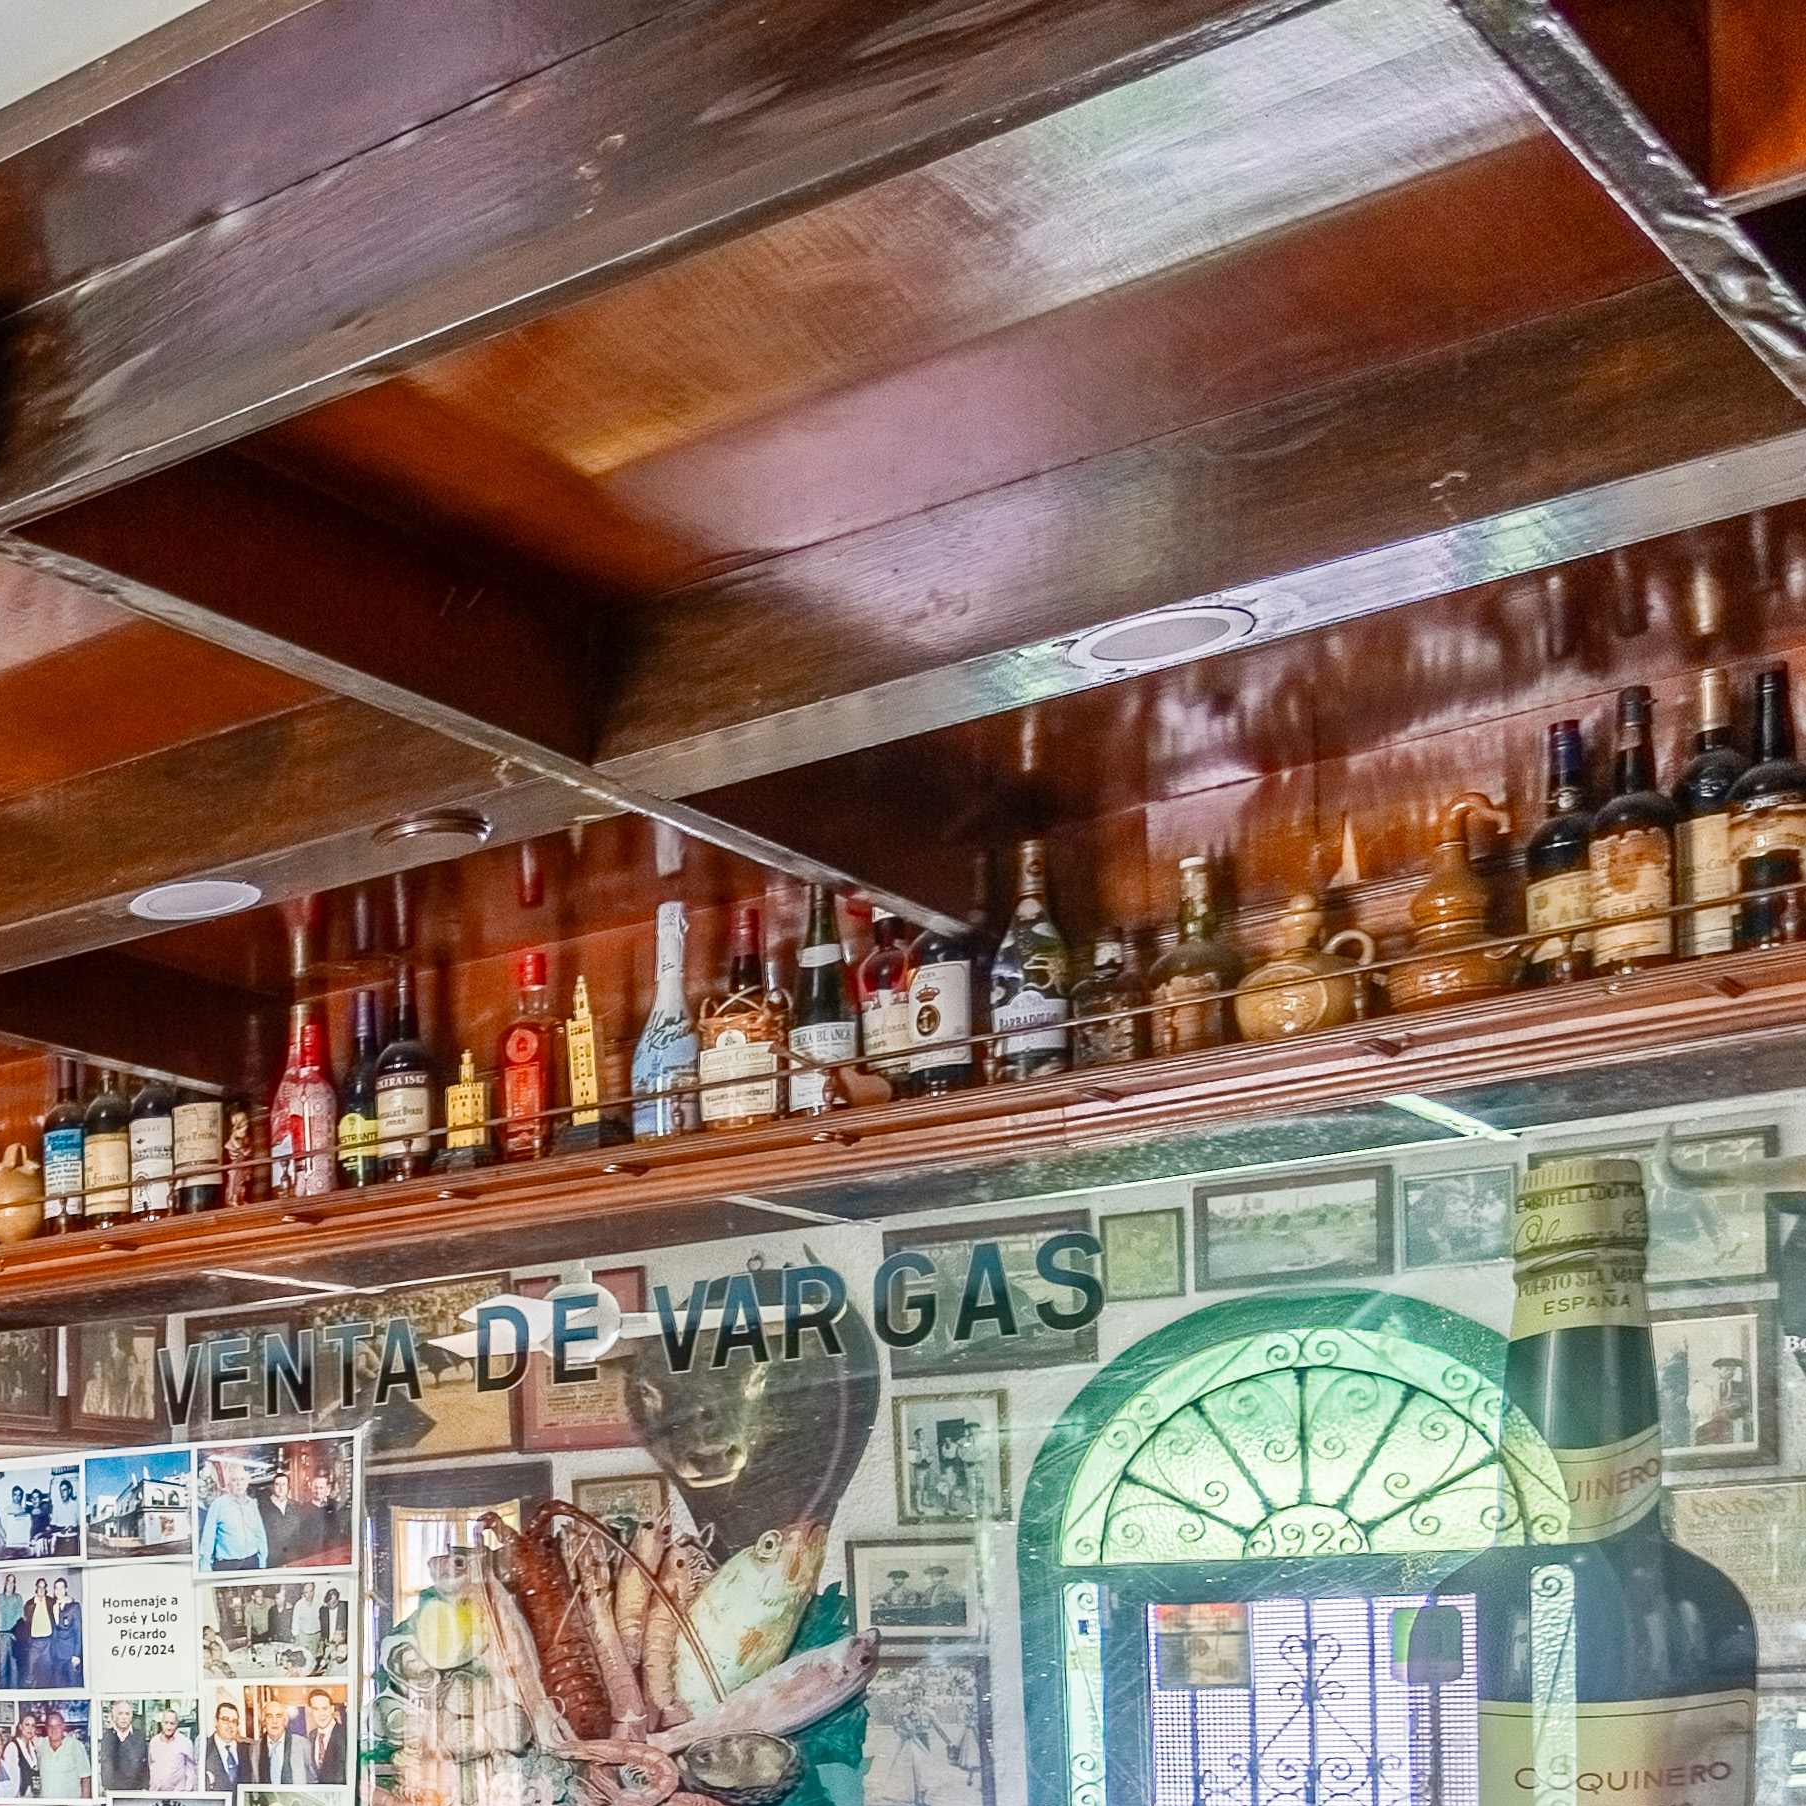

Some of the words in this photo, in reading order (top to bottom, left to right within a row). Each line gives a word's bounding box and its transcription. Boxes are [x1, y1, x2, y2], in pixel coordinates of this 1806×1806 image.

[1518, 1272, 1572, 1298] PUERTO
[1543, 1289, 1631, 1316] ESPAÑA
[156, 1317, 424, 1428] VENTA
[475, 1291, 600, 1393] DE
[652, 1231, 1105, 1375] VARGAS
[102, 1596, 167, 1609] Homenaje
[171, 1596, 178, 1606] a
[107, 1612, 137, 1625] José
[140, 1614, 148, 1626] y
[151, 1611, 178, 1623] Lolo
[120, 1628, 167, 1640] Picardo
[111, 1644, 175, 1658] 6/6/2024
[1514, 1761, 1732, 1795] COQUINERO
